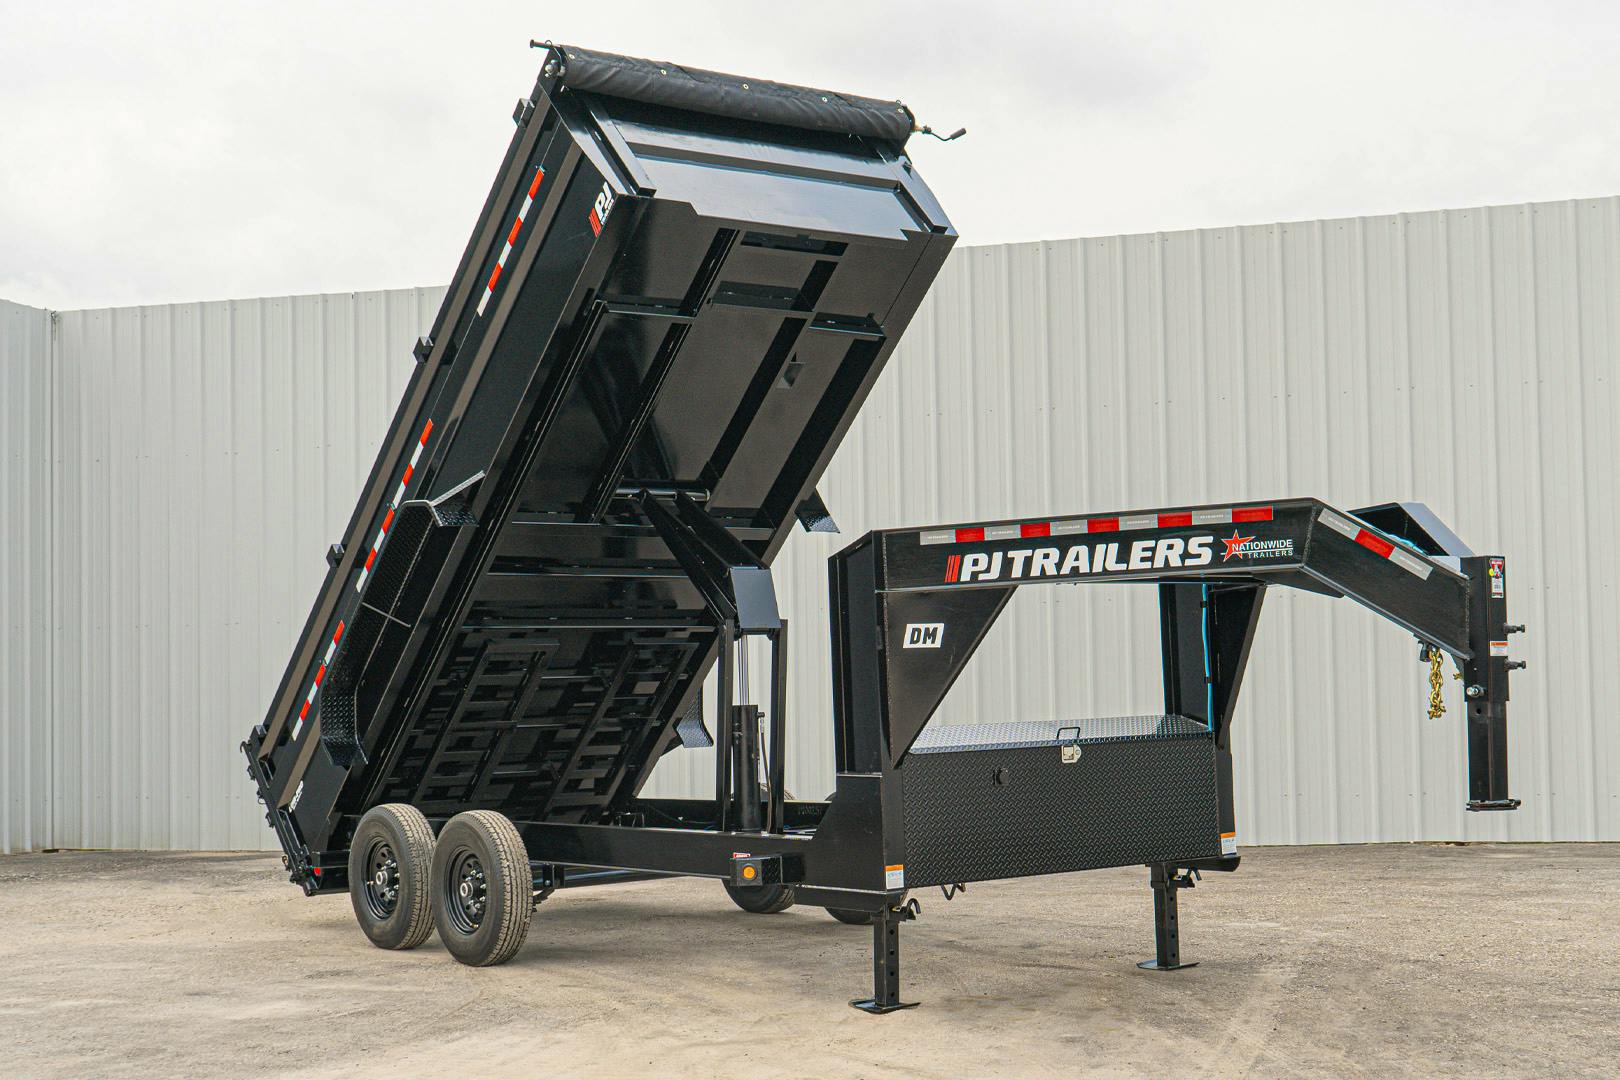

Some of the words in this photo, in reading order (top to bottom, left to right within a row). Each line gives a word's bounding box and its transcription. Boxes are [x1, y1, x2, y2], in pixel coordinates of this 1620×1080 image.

[1231, 539, 1293, 552] NATIONWIDE
[1247, 550, 1293, 559] TRAILERS
[909, 626, 939, 645] DM
